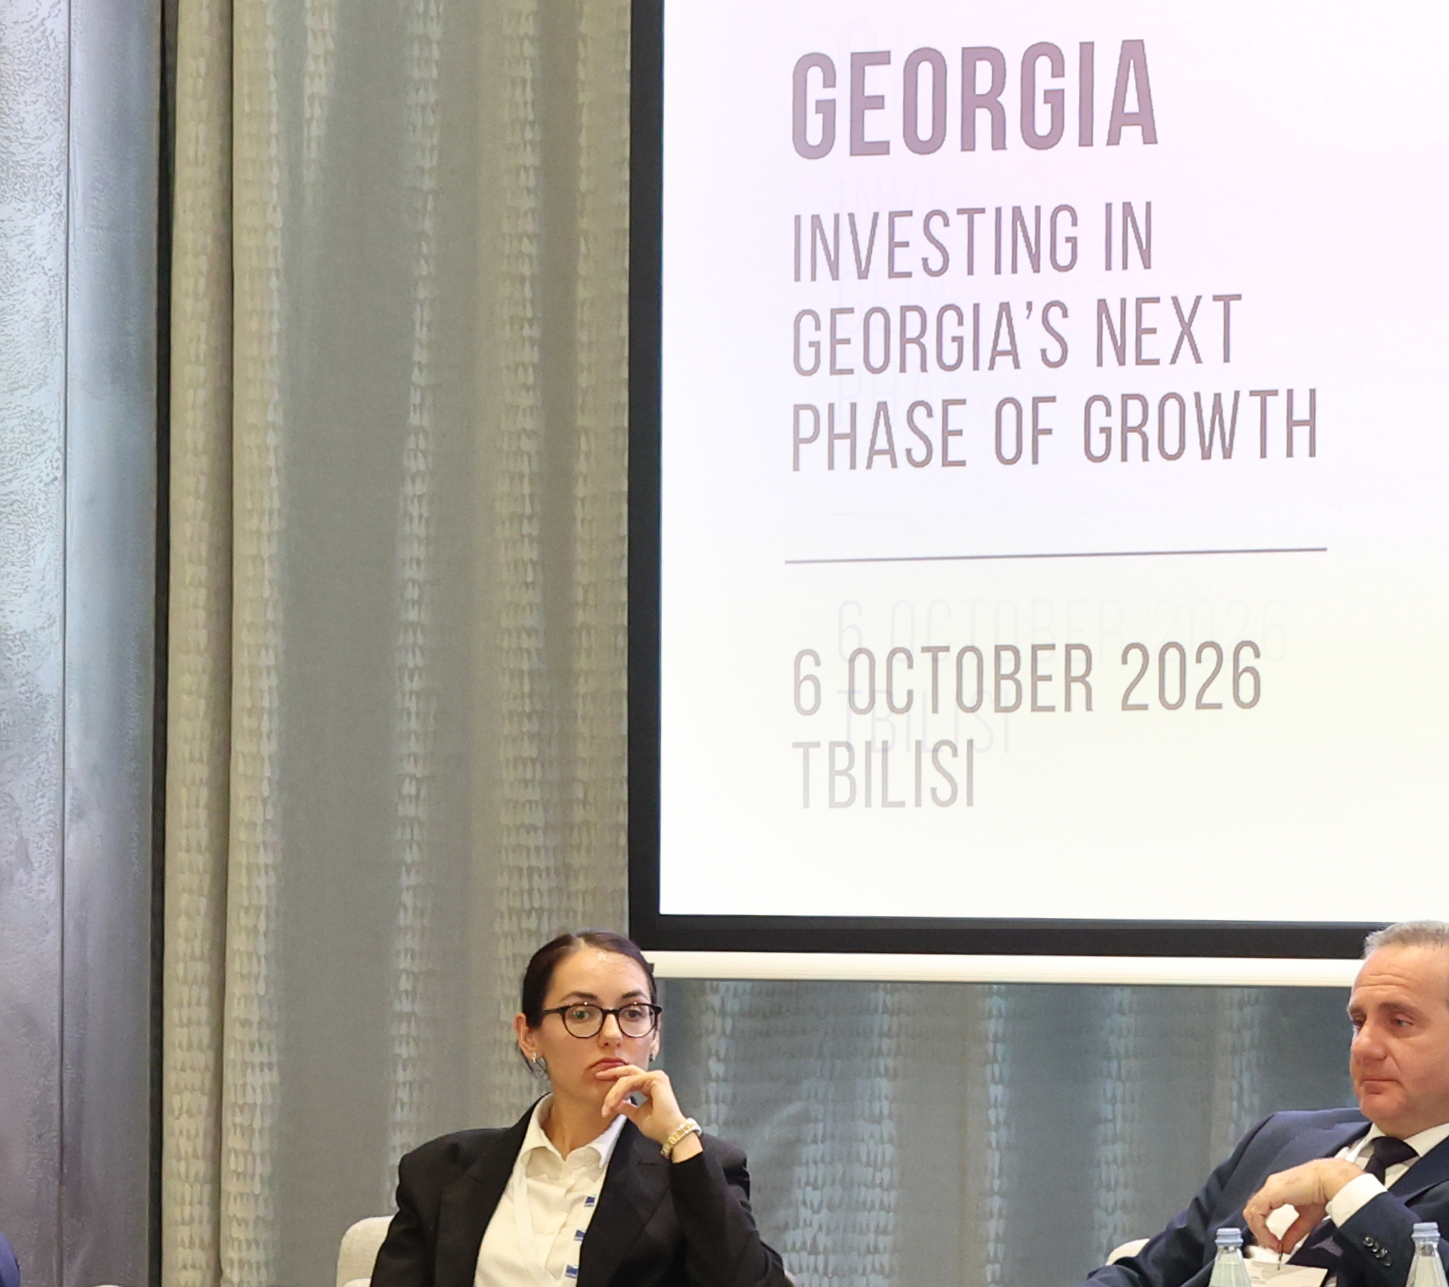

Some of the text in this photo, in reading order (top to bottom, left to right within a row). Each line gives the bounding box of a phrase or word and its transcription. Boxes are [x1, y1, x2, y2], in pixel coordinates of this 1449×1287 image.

[792, 39, 1158, 160] GEORGIA
[794, 201, 1151, 282] INVESTING IN
[1097, 294, 1242, 367] NEXT
[793, 388, 1316, 472] PHASE OF GROWTH
[794, 640, 1261, 716] 6 OCTOBER 2026
[792, 738, 974, 808] TBILISI
